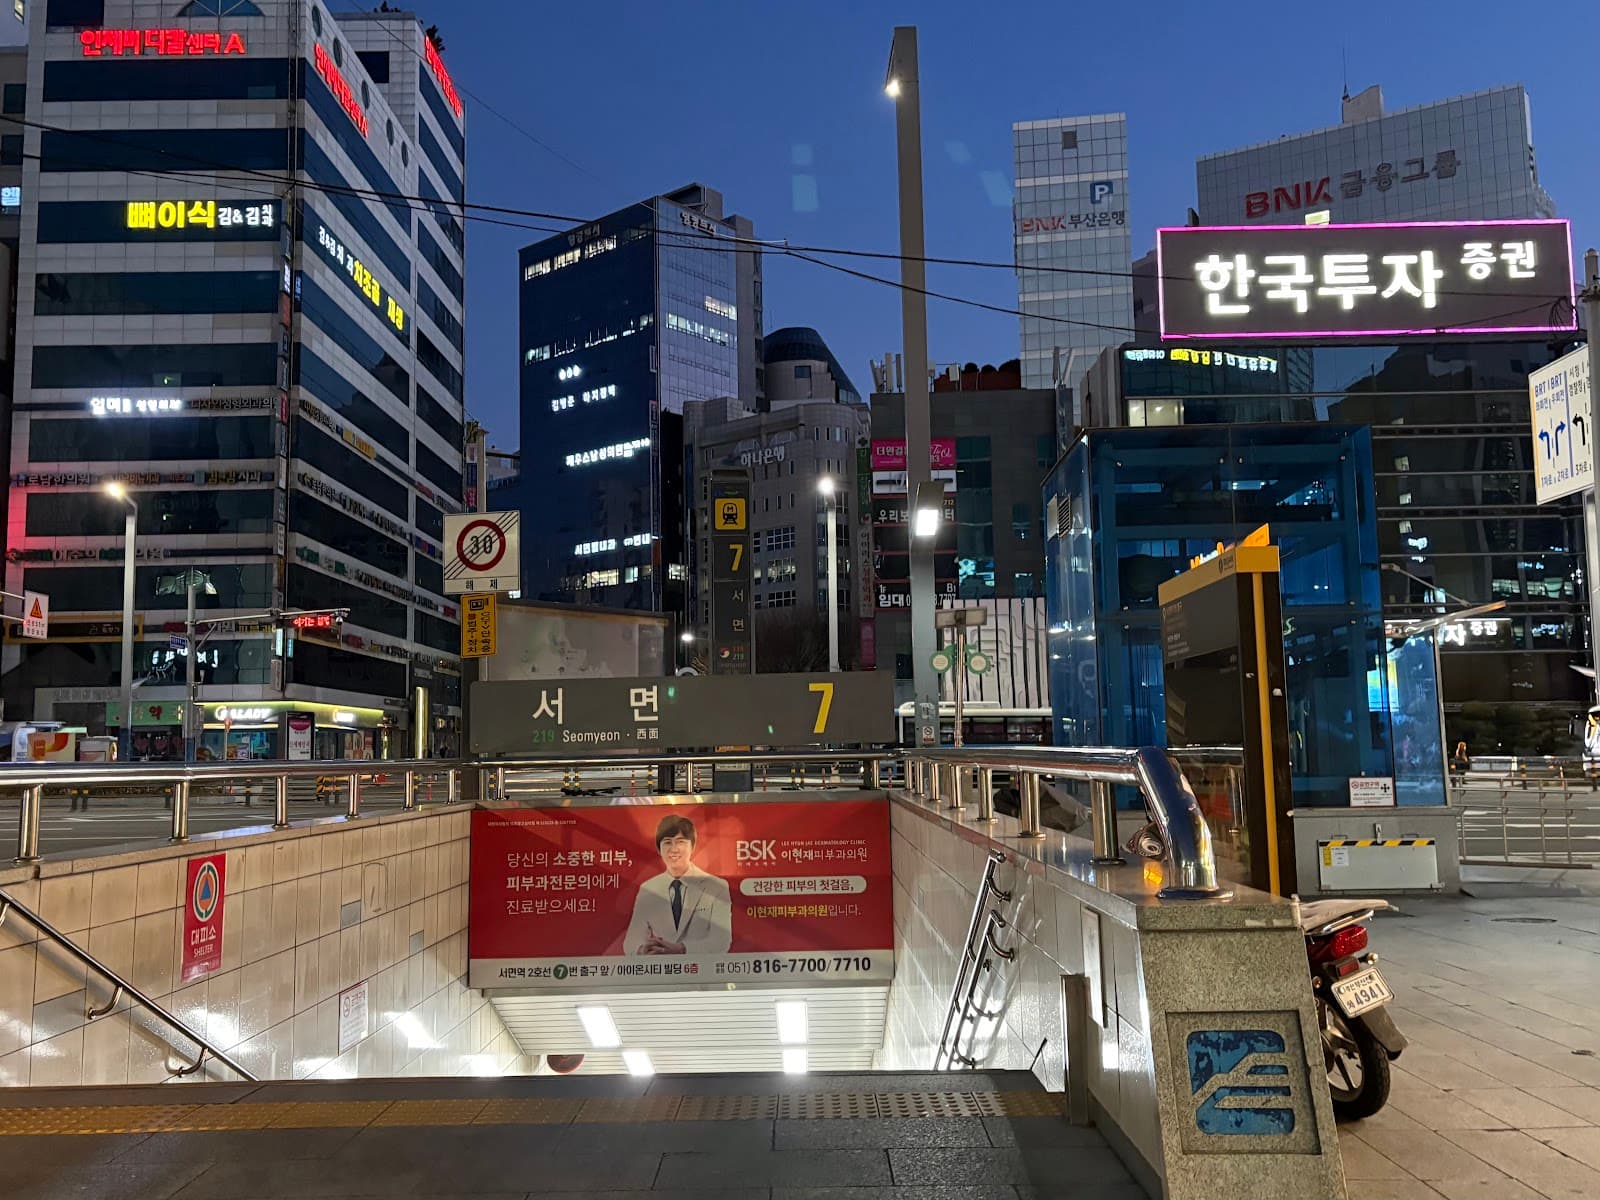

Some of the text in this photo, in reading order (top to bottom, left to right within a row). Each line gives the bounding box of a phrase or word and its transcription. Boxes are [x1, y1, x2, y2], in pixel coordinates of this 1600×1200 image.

[1244, 148, 1462, 219] BNK 금융그룹
[127, 200, 215, 228] 뼈이식
[1068, 210, 1125, 229] 부산은행
[1194, 240, 1537, 315] 한국투자 증권
[470, 535, 493, 555] 30
[729, 544, 744, 572] 7
[878, 593, 905, 608] 임대
[808, 682, 835, 735] 7
[532, 728, 660, 744] 219 Seomyeon 西面
[507, 850, 633, 868] 당신의 소중한 피부,
[736, 839, 777, 861] BSK
[781, 847, 868, 863] 이현재피부과의원
[506, 873, 620, 891] 피부과전문의에게
[753, 879, 854, 893] 건강한 피부의 첫걸음,
[506, 898, 596, 915] 진료받으세요!
[191, 924, 217, 946] 대피소
[193, 943, 215, 959] SHELTER
[498, 967, 526, 979] 서면역
[527, 966, 551, 978] 2호선
[580, 965, 598, 977] 출구
[600, 965, 610, 977] 앞
[617, 964, 662, 977] 아이온시티
[664, 963, 682, 975] 빌딩
[684, 962, 699, 975] 6층
[1354, 983, 1385, 1005] 4941
